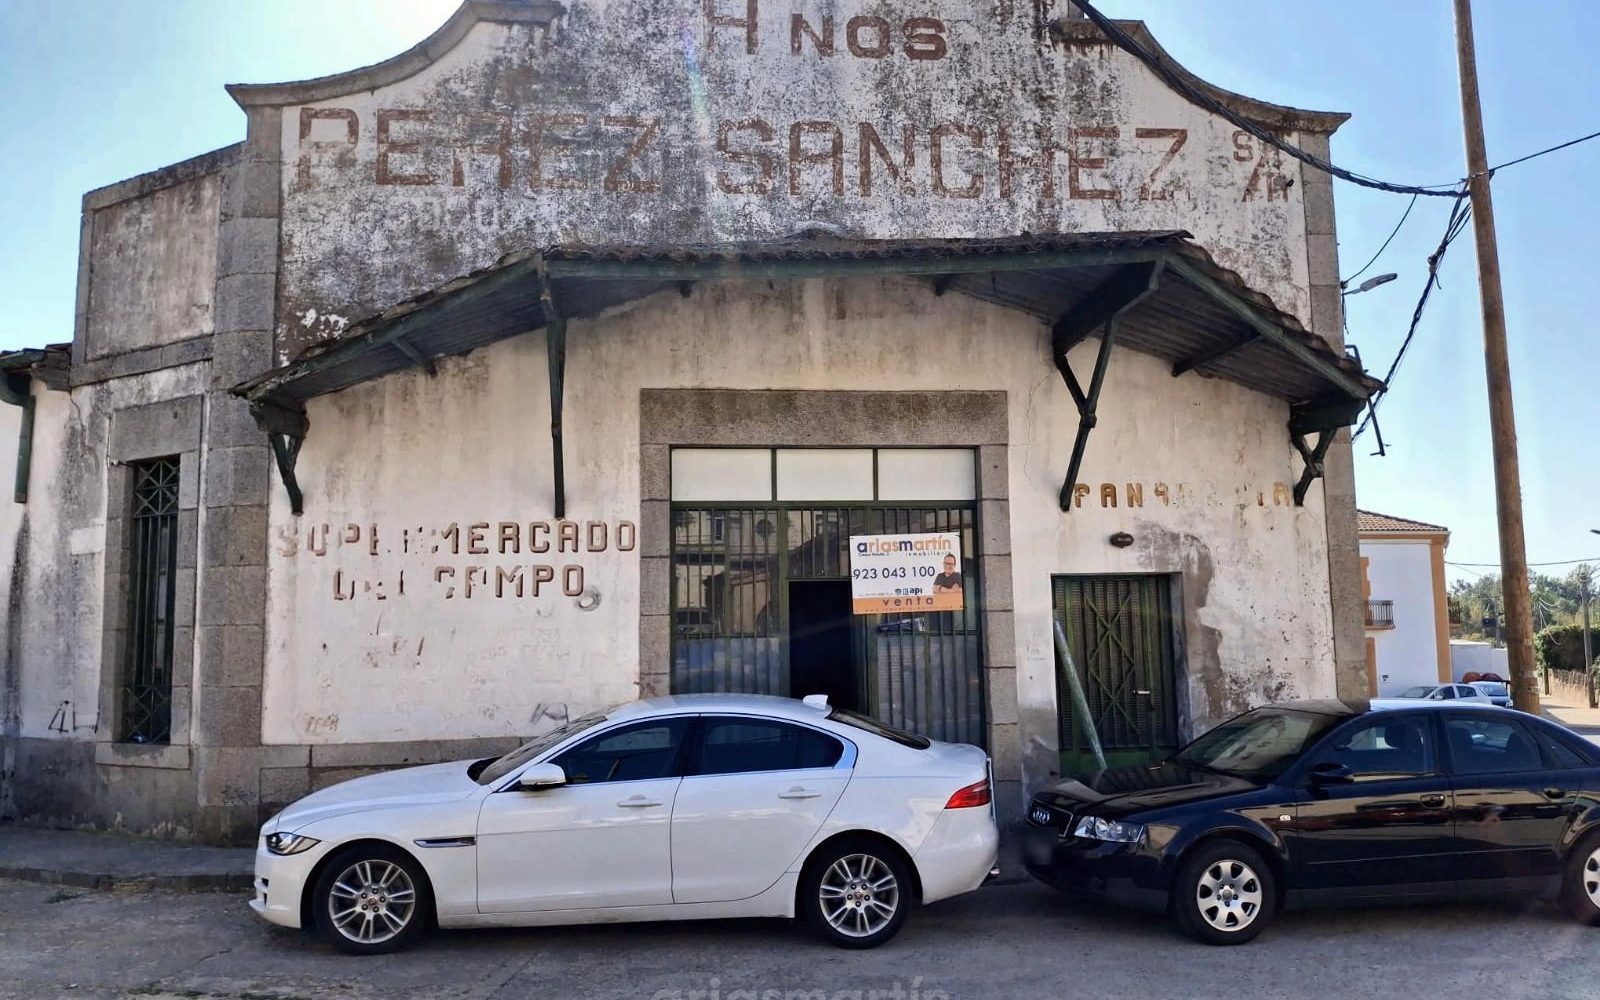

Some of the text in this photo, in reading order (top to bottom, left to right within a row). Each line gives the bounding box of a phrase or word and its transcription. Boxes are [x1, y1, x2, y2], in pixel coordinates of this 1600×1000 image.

[297, 107, 662, 194] PEREZ
[714, 118, 1190, 202] SANCHEZ
[857, 535, 952, 552] ariasmartín
[853, 566, 936, 580] 923 043 100
[882, 596, 934, 606] venta
